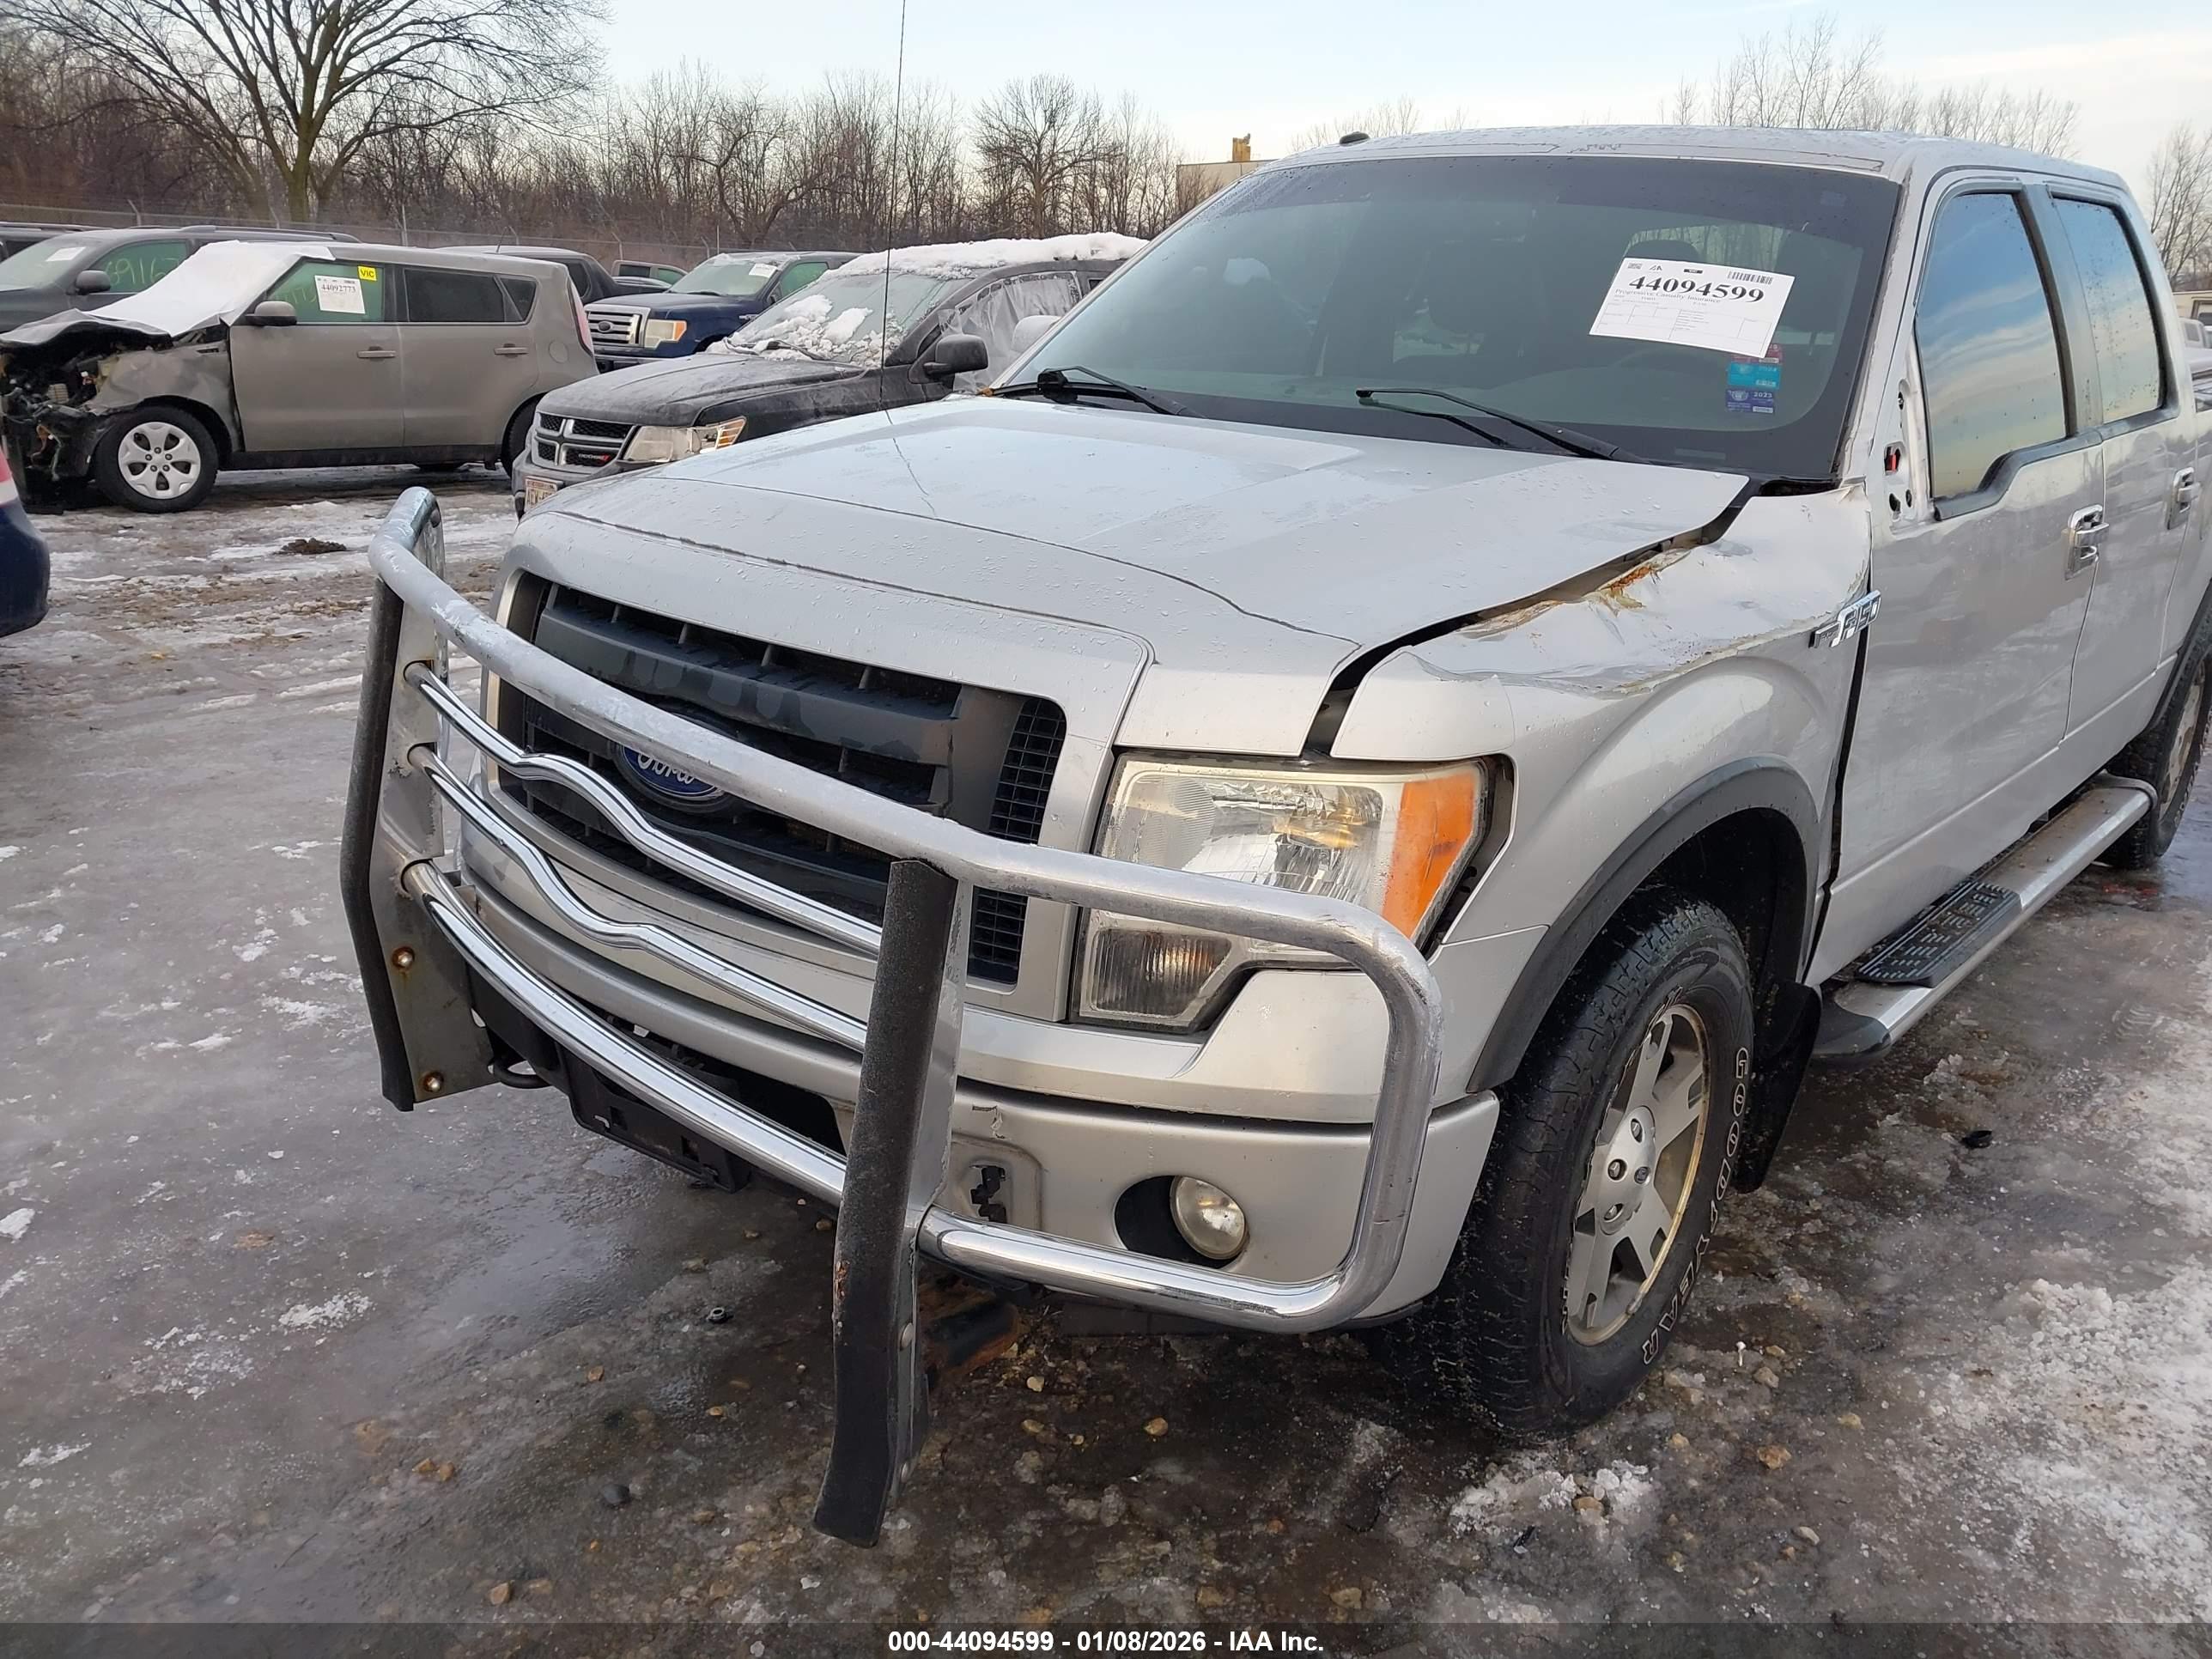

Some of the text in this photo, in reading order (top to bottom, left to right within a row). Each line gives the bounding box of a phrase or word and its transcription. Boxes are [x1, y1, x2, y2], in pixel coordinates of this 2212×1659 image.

[359, 269, 375, 278] VIC
[320, 283, 357, 294] 44092773
[1628, 276, 1765, 303] 44094599
[1640, 1046, 1750, 1366] GOODYEAR
